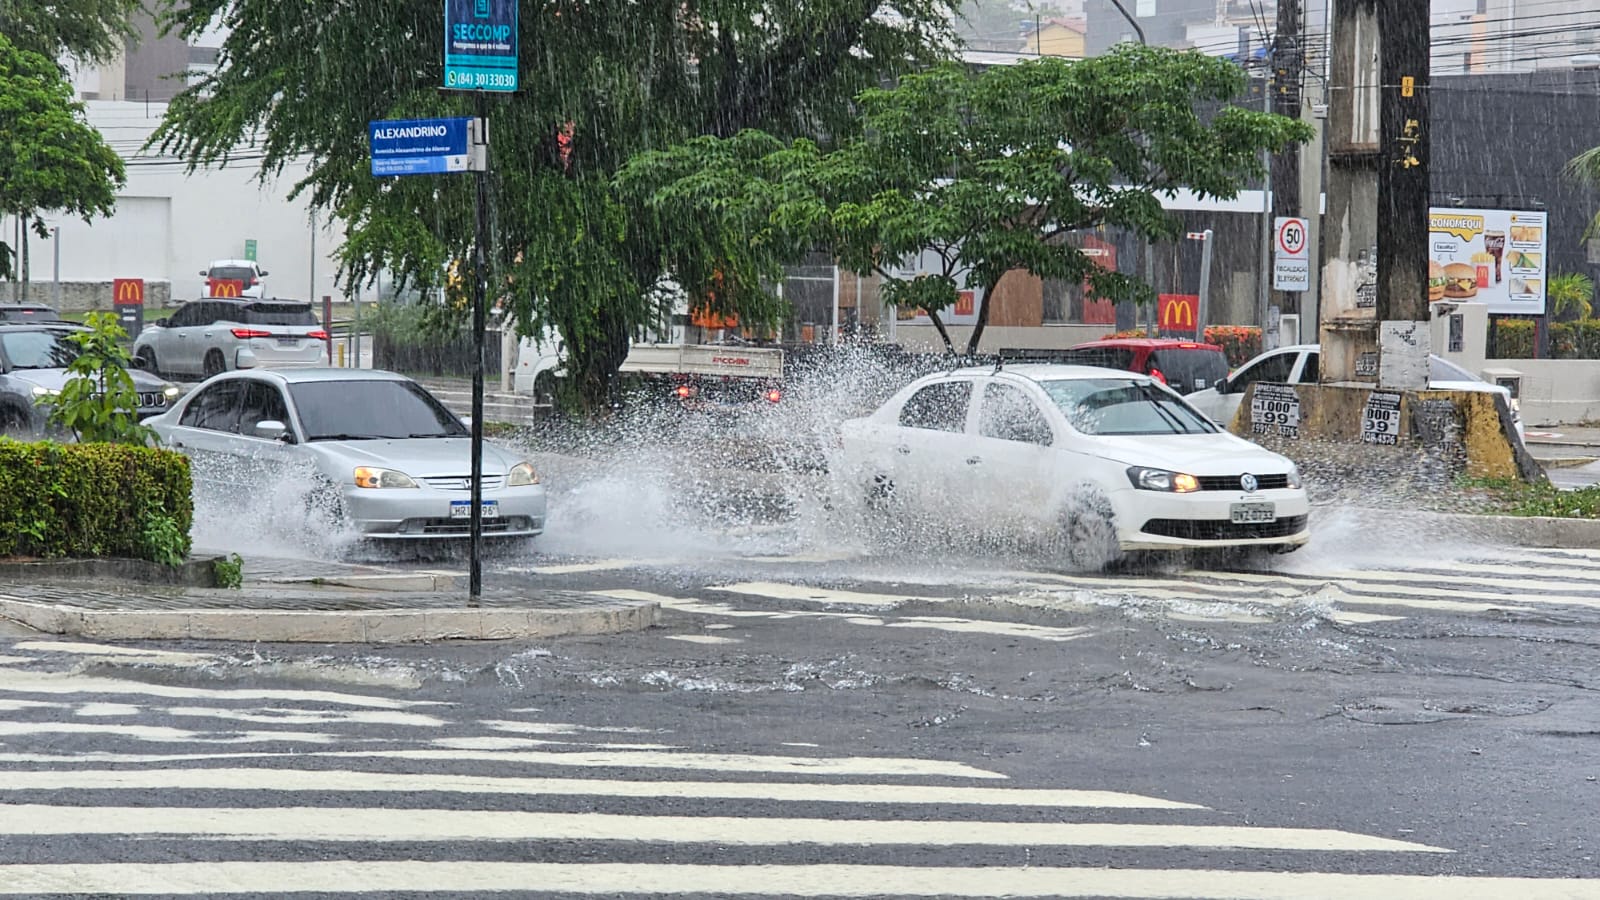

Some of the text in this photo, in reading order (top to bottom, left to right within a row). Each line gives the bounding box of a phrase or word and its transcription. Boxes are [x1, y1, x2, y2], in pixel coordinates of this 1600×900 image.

[453, 24, 510, 41] SEGCOMP
[458, 73, 515, 87] (84) 30133030
[374, 126, 447, 139] ALEXANDRINO
[1429, 216, 1481, 229] CONOMÉQUI
[1286, 228, 1300, 244] 50
[1264, 412, 1288, 424] 99
[1365, 420, 1388, 432] 99
